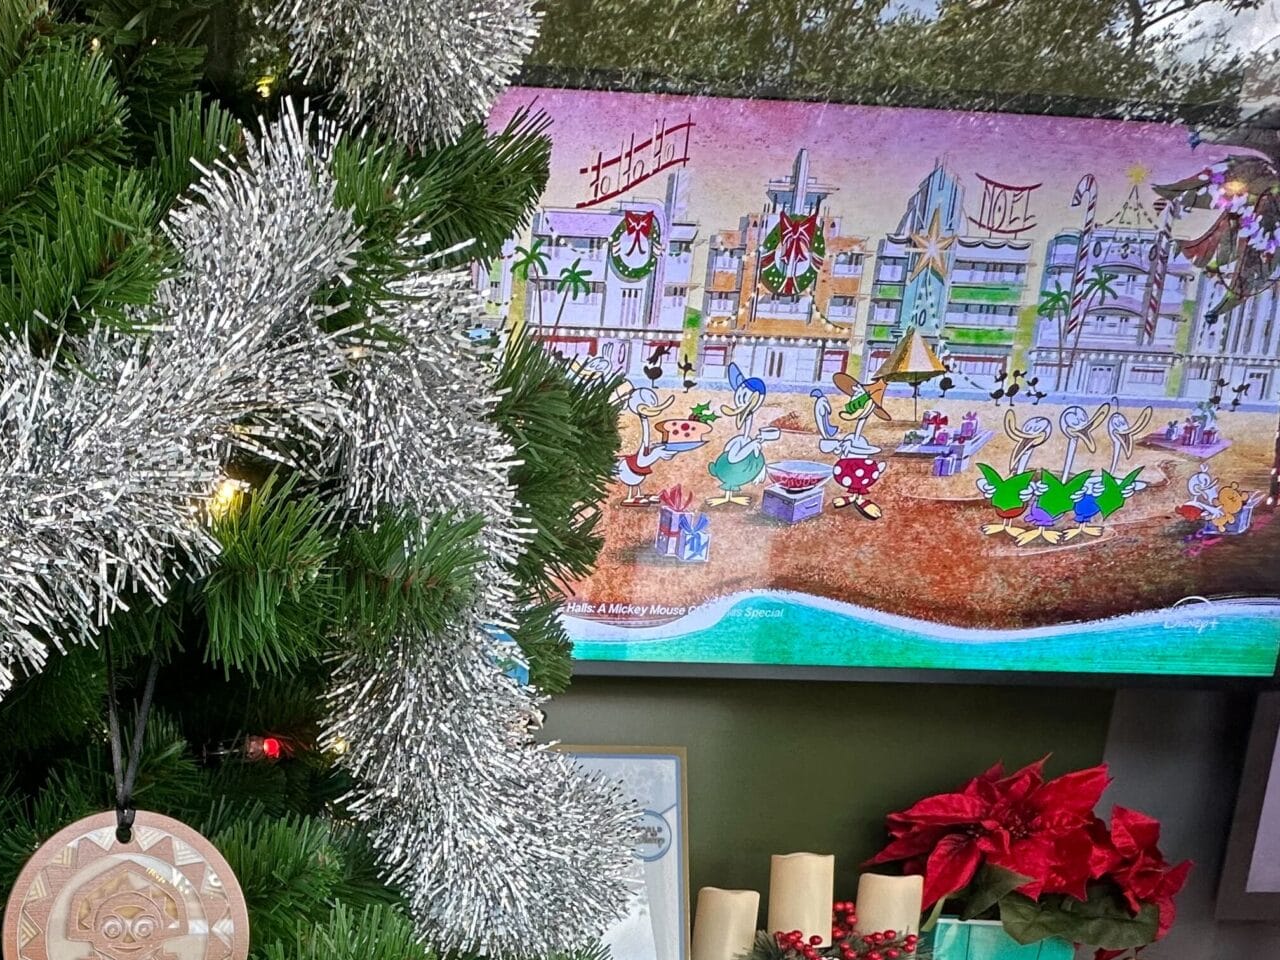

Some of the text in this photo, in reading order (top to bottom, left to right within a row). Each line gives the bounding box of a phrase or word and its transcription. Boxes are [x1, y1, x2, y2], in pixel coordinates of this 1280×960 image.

[979, 182, 1036, 229] NOEL
[566, 602, 596, 614] Halls:
[597, 603, 607, 614] A
[608, 603, 648, 618] Mickey
[649, 605, 686, 616] Mouse
[744, 606, 784, 620] Special
